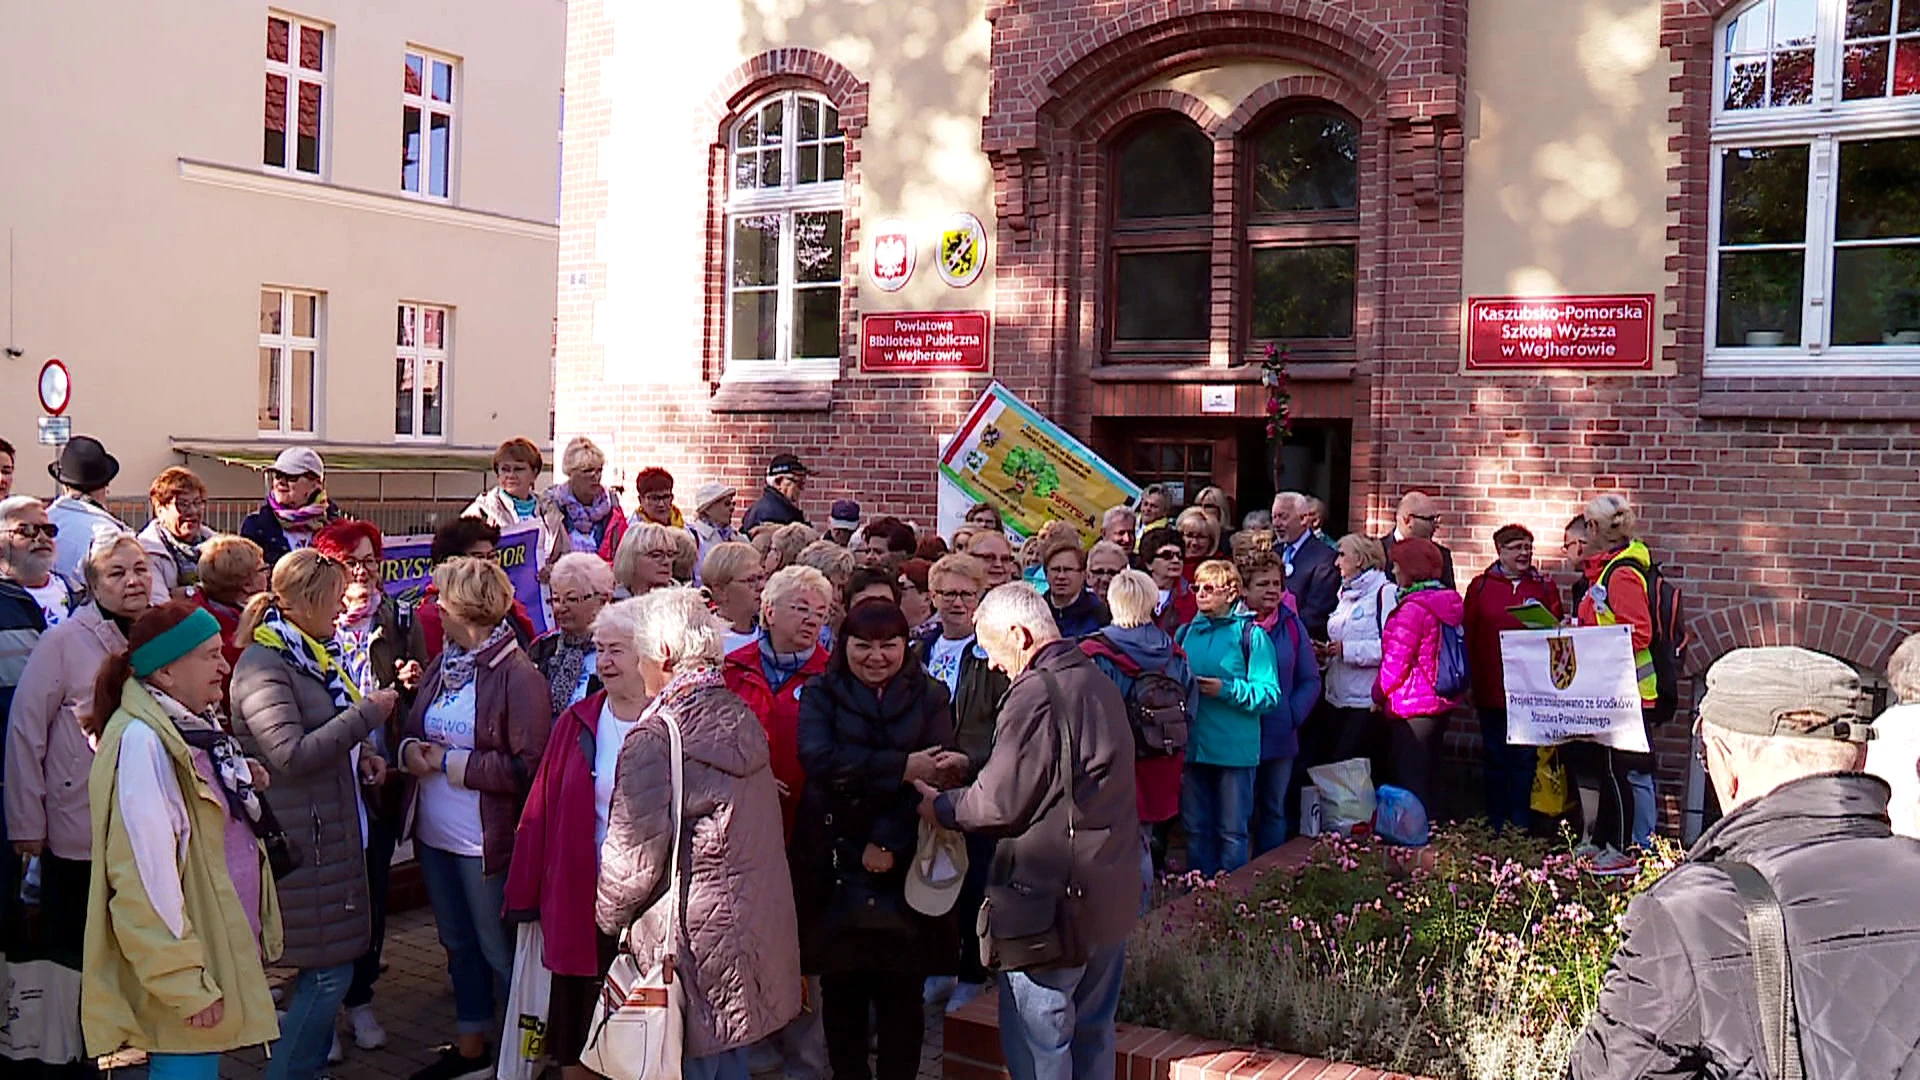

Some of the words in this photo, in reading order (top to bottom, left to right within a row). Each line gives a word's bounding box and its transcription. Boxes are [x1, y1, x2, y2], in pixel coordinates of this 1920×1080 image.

[1478, 304, 1643, 321] Kaszubsko-Pomorska
[894, 319, 953, 332] Powiatowa
[1501, 323, 1552, 339] Szkoła
[1556, 322, 1616, 341] Wyższa
[869, 335, 922, 347] Biblioteka
[925, 333, 980, 347] Publiczna
[884, 351, 893, 361] w
[896, 348, 962, 364] Wejherowie
[1501, 344, 1515, 356] w
[1519, 341, 1616, 359] Wejherowie
[1585, 699, 1594, 709] ze
[1596, 696, 1633, 709] środków
[1558, 711, 1611, 729] Powiatowego
